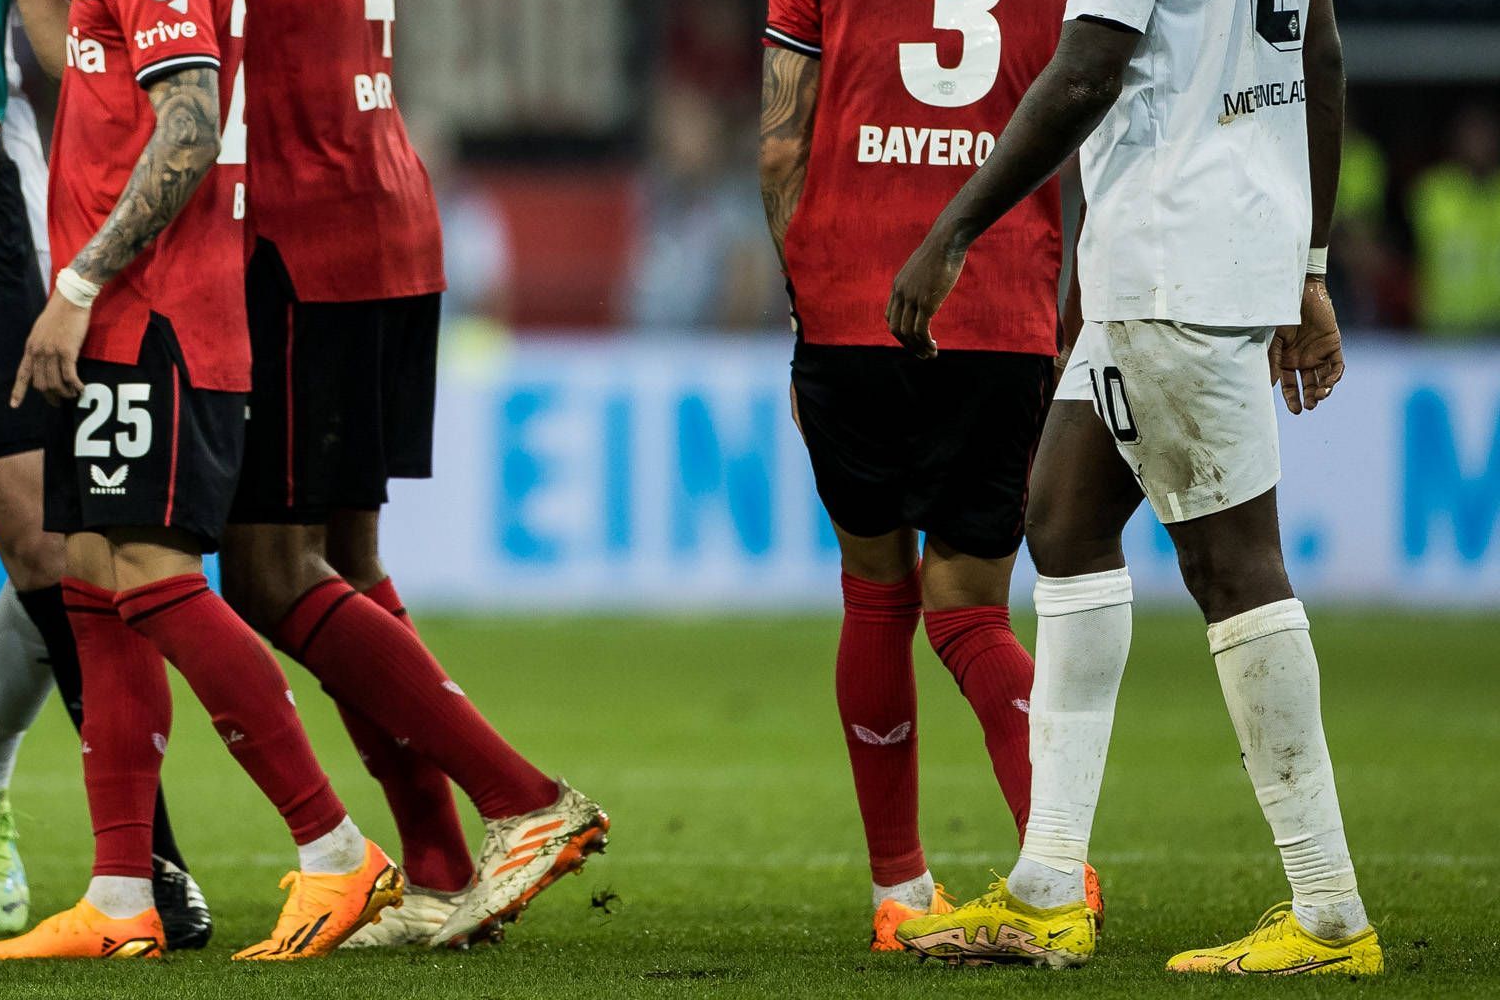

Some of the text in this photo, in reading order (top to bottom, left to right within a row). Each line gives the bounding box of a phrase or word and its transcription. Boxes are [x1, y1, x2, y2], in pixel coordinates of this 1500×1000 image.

[134, 20, 197, 50] trive
[857, 125, 996, 168] BAYER0
[74, 383, 153, 458] 25
[1090, 366, 1142, 445] 10
